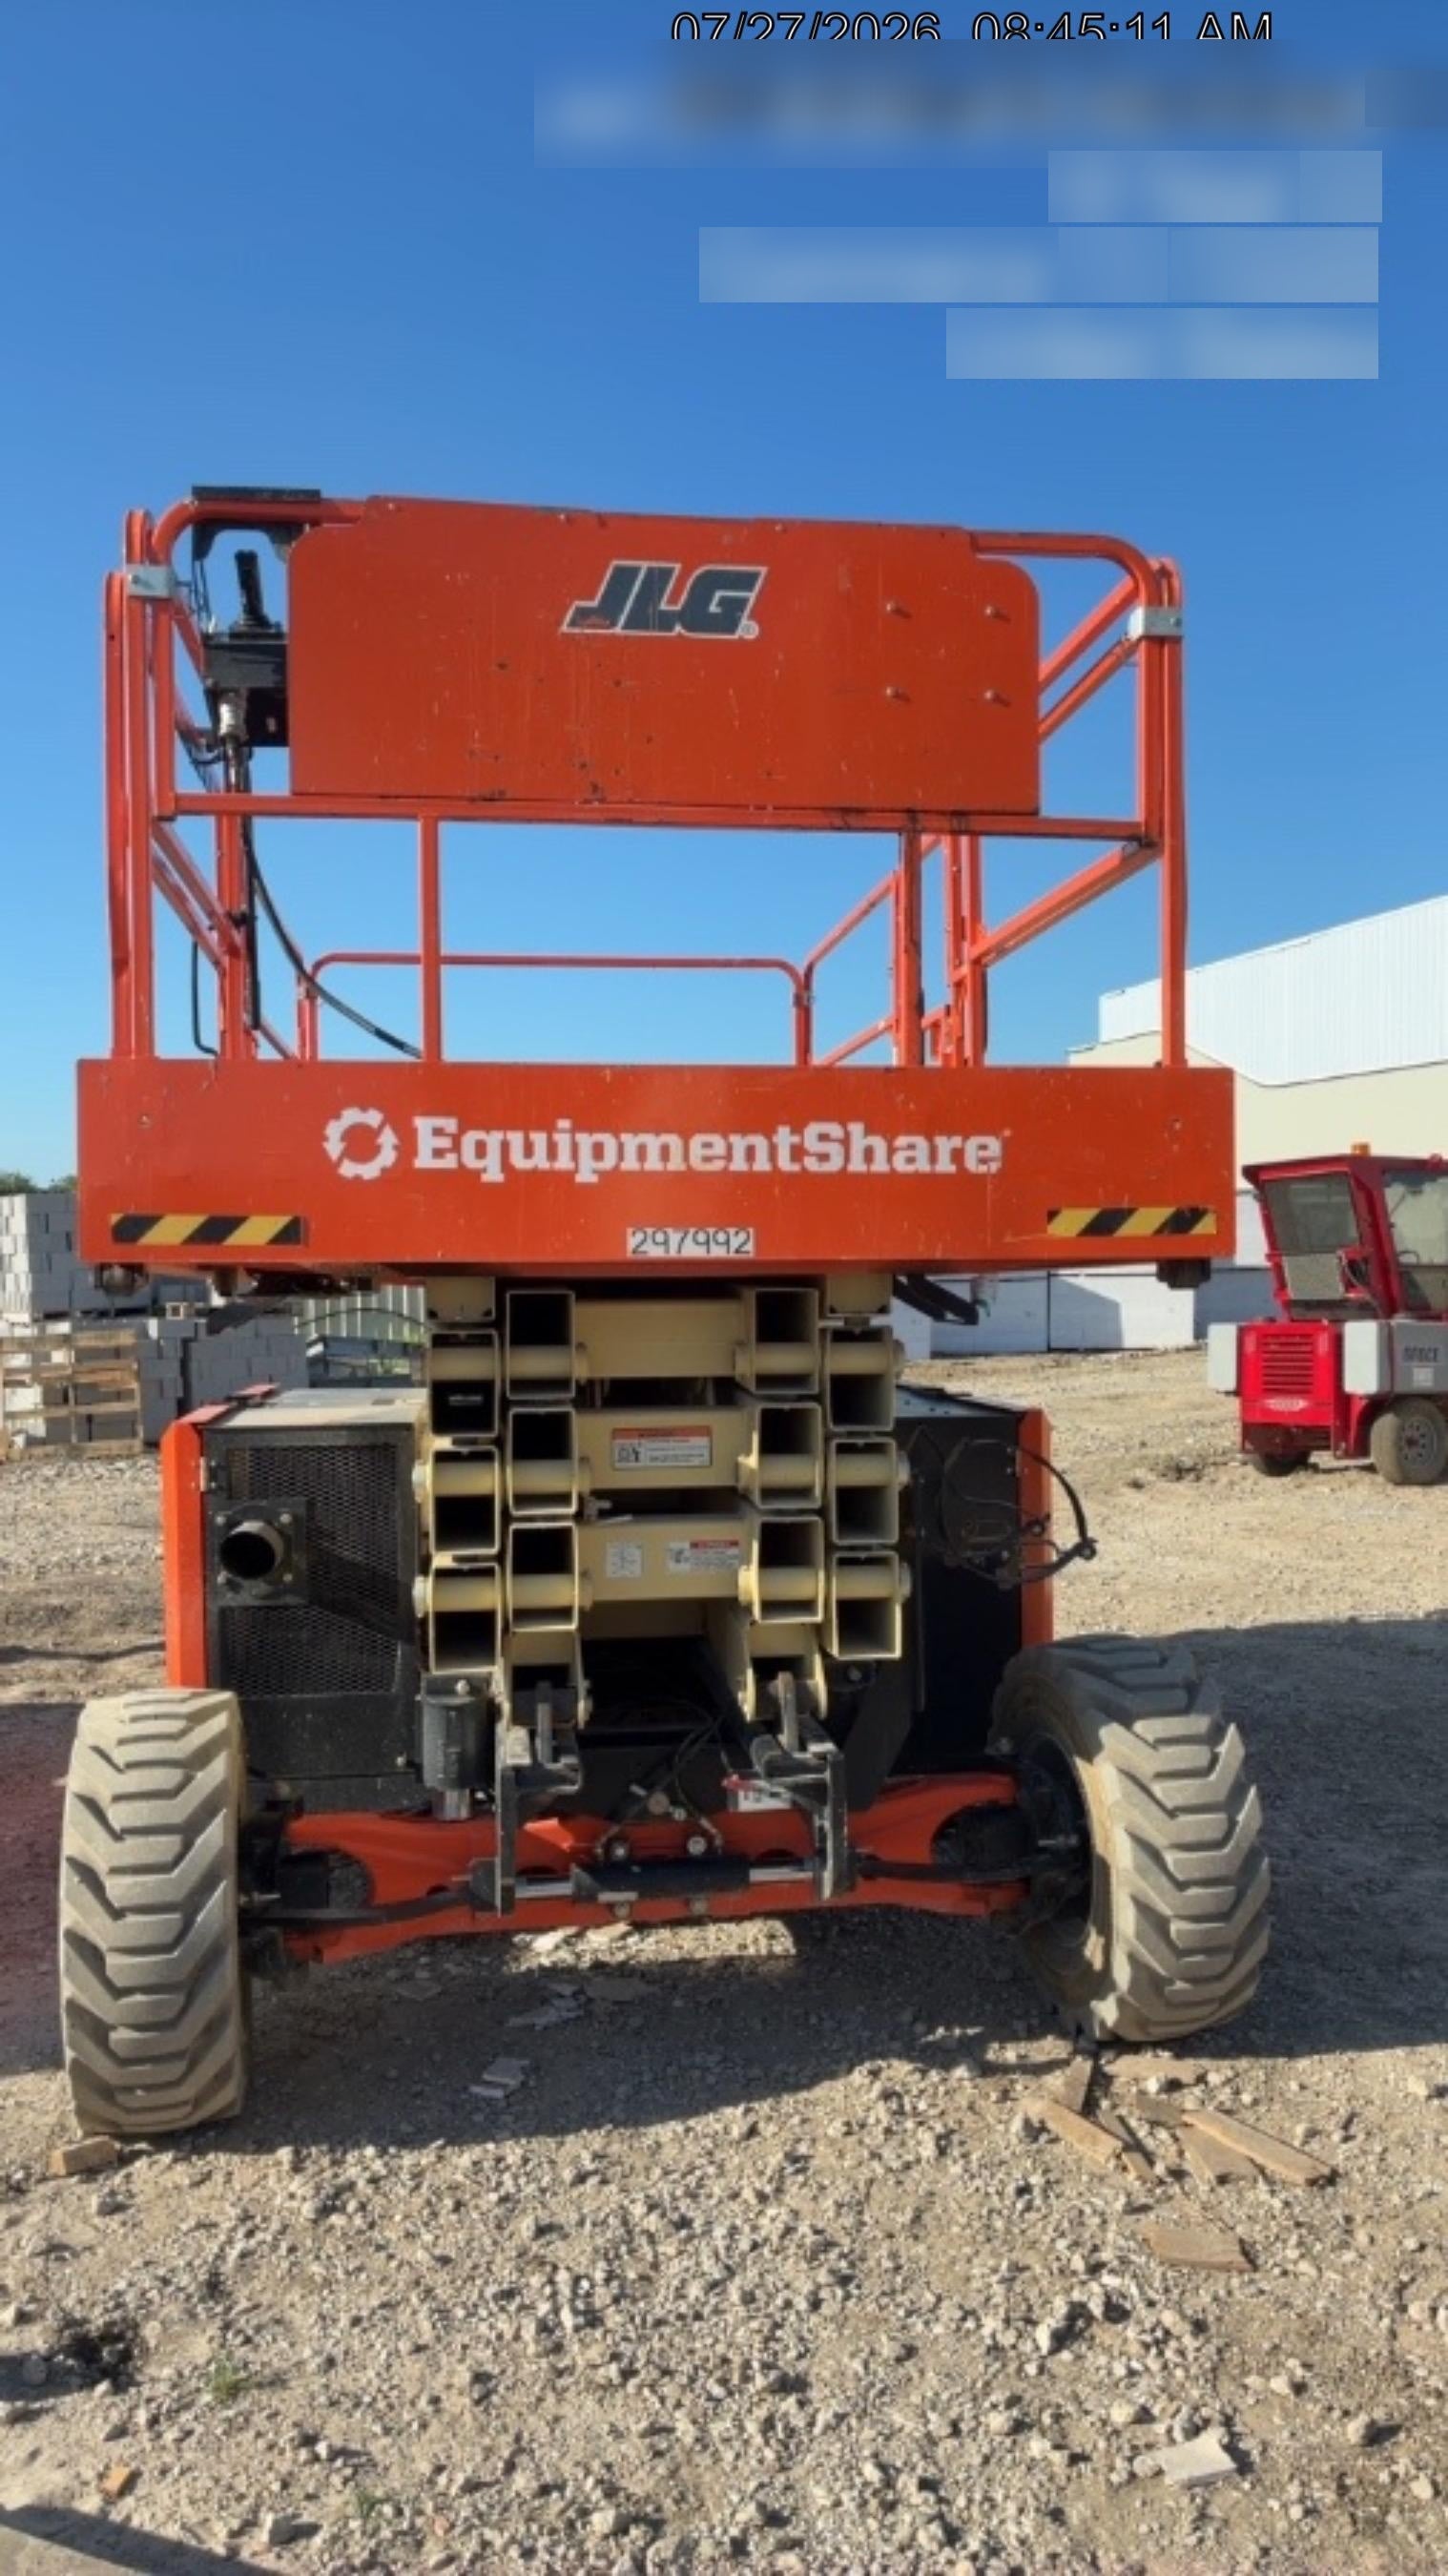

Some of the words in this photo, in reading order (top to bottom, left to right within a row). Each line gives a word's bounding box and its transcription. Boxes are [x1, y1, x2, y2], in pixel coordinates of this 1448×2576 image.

[560, 560, 767, 638] JLG
[413, 1115, 1003, 1183] EquipmentShare
[631, 1227, 752, 1256] 297992
